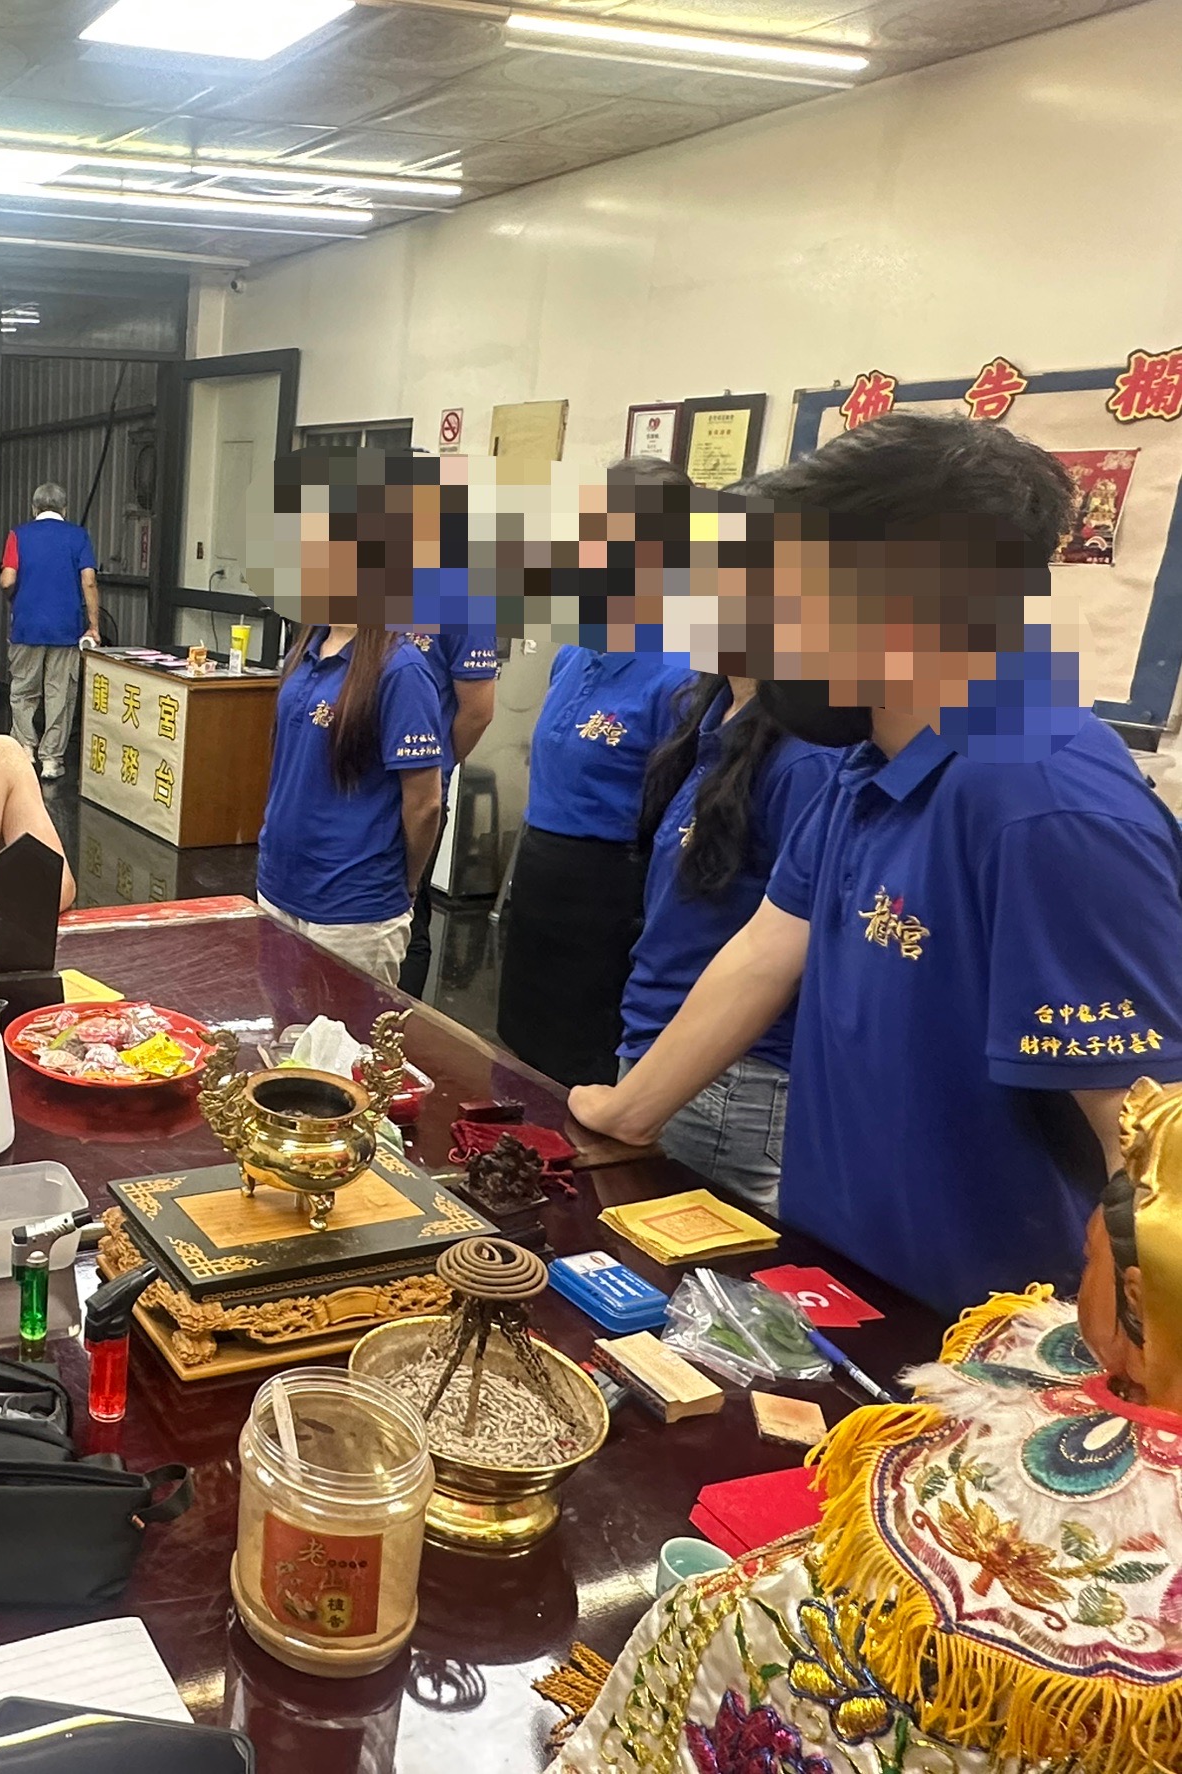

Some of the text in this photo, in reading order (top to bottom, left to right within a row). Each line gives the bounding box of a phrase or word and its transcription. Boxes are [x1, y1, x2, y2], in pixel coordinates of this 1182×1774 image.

[841, 347, 1182, 430] 佈告欄
[92, 673, 179, 740] 龍天宮
[90, 733, 174, 808] 服務台
